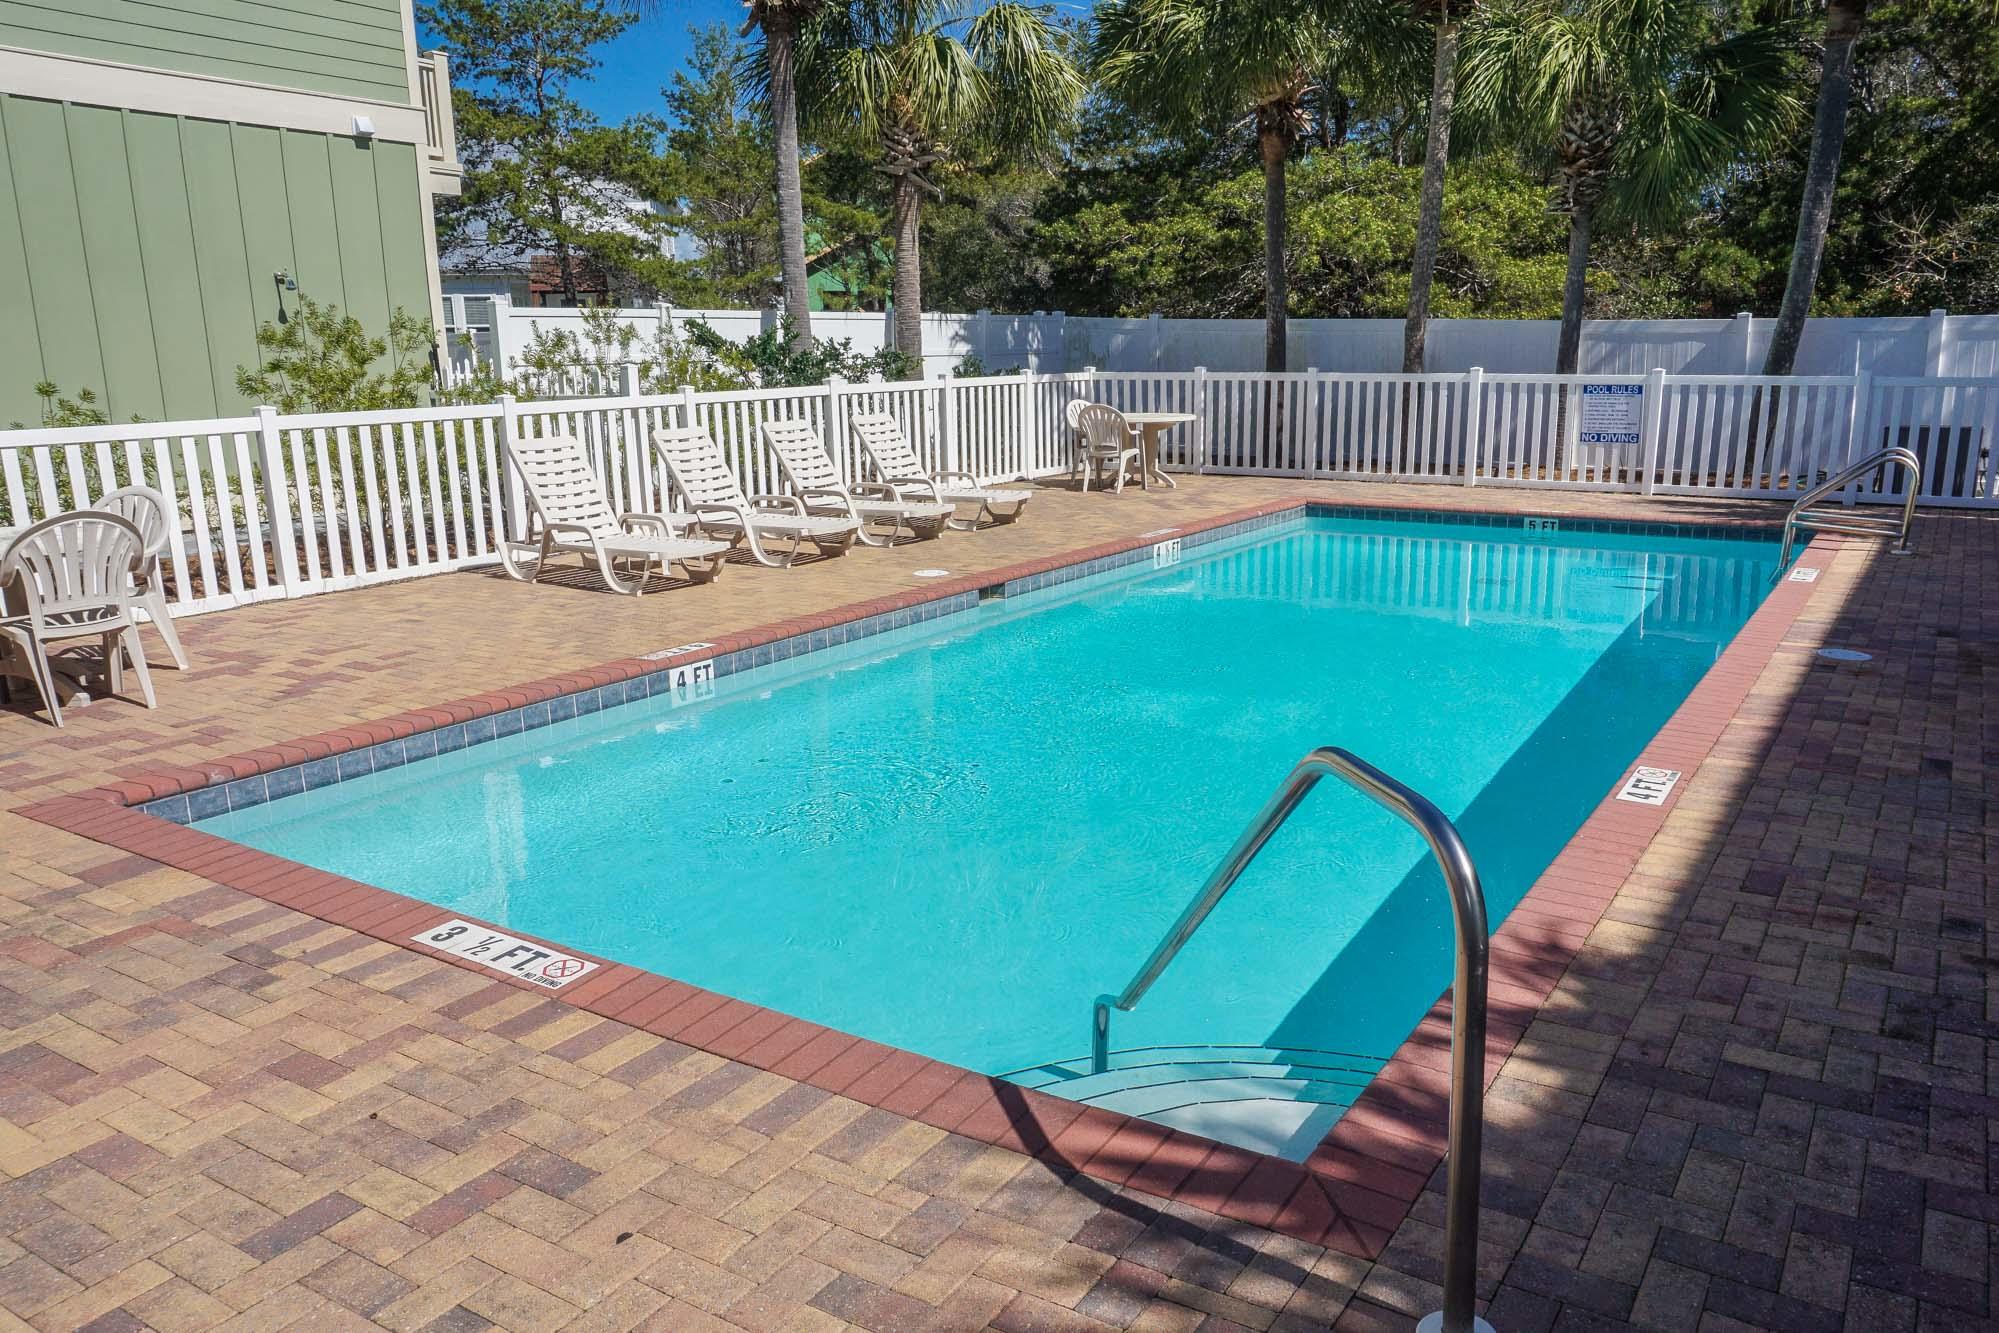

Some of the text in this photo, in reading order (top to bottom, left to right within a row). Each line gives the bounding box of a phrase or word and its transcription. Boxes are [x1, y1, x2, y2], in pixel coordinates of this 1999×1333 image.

[1587, 385, 1639, 394] POOL RULES
[1581, 433, 1638, 443] NO DIVING
[1528, 520, 1557, 531] 5 FT
[676, 663, 712, 688] 4 FT
[1625, 791, 1659, 800] 4
[430, 926, 469, 942] 3
[489, 944, 552, 971] FT.
[520, 971, 537, 980] NO
